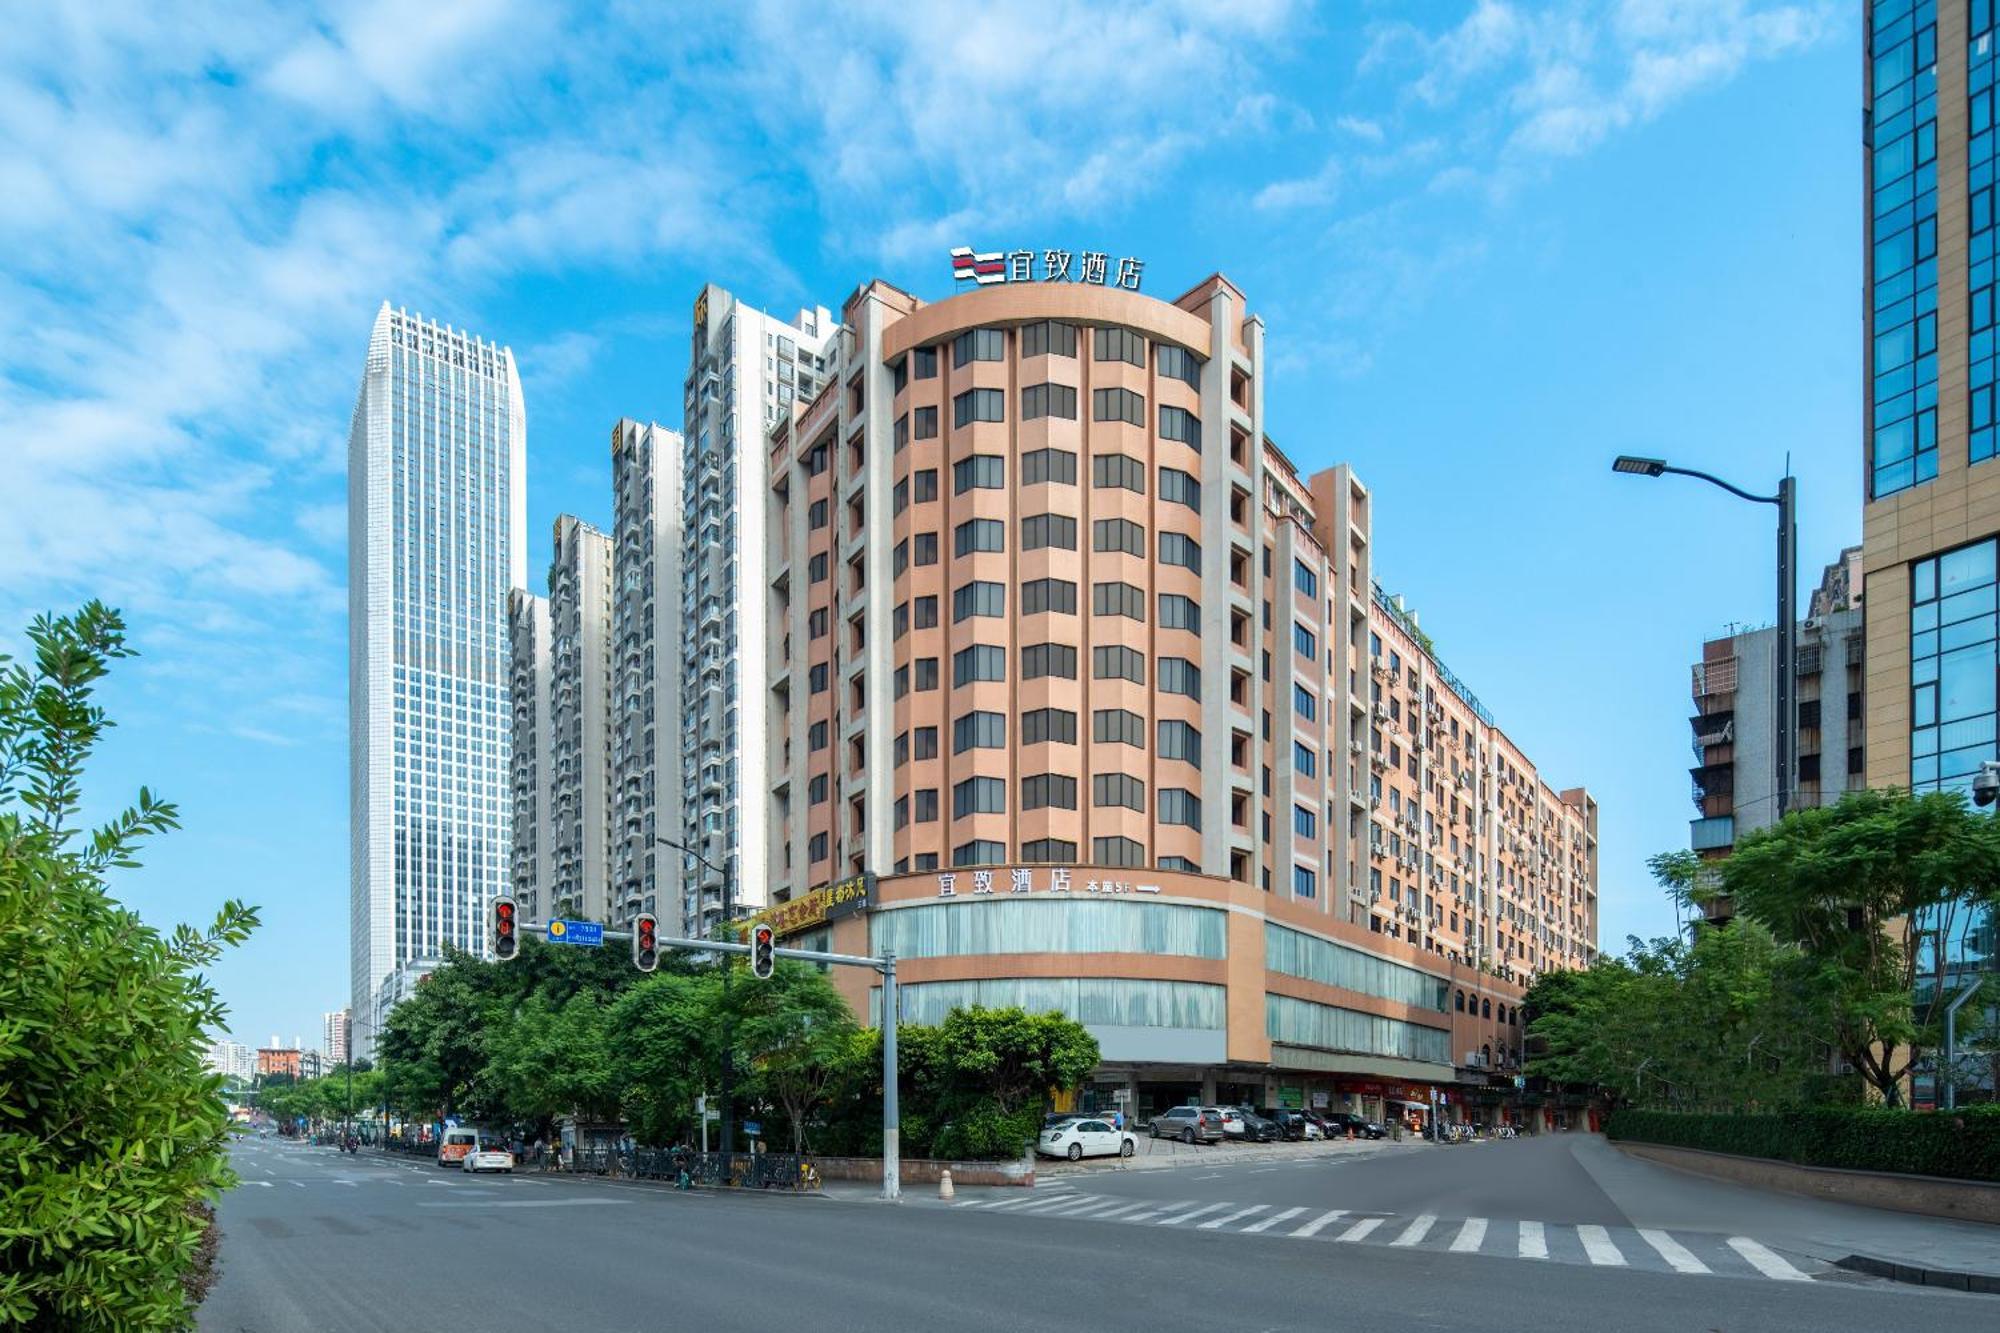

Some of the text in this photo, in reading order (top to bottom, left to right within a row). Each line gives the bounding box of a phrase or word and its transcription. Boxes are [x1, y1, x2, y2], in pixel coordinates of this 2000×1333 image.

[1008, 249, 1145, 290] 宜致酒店
[937, 867, 1072, 897] 宜致酒店
